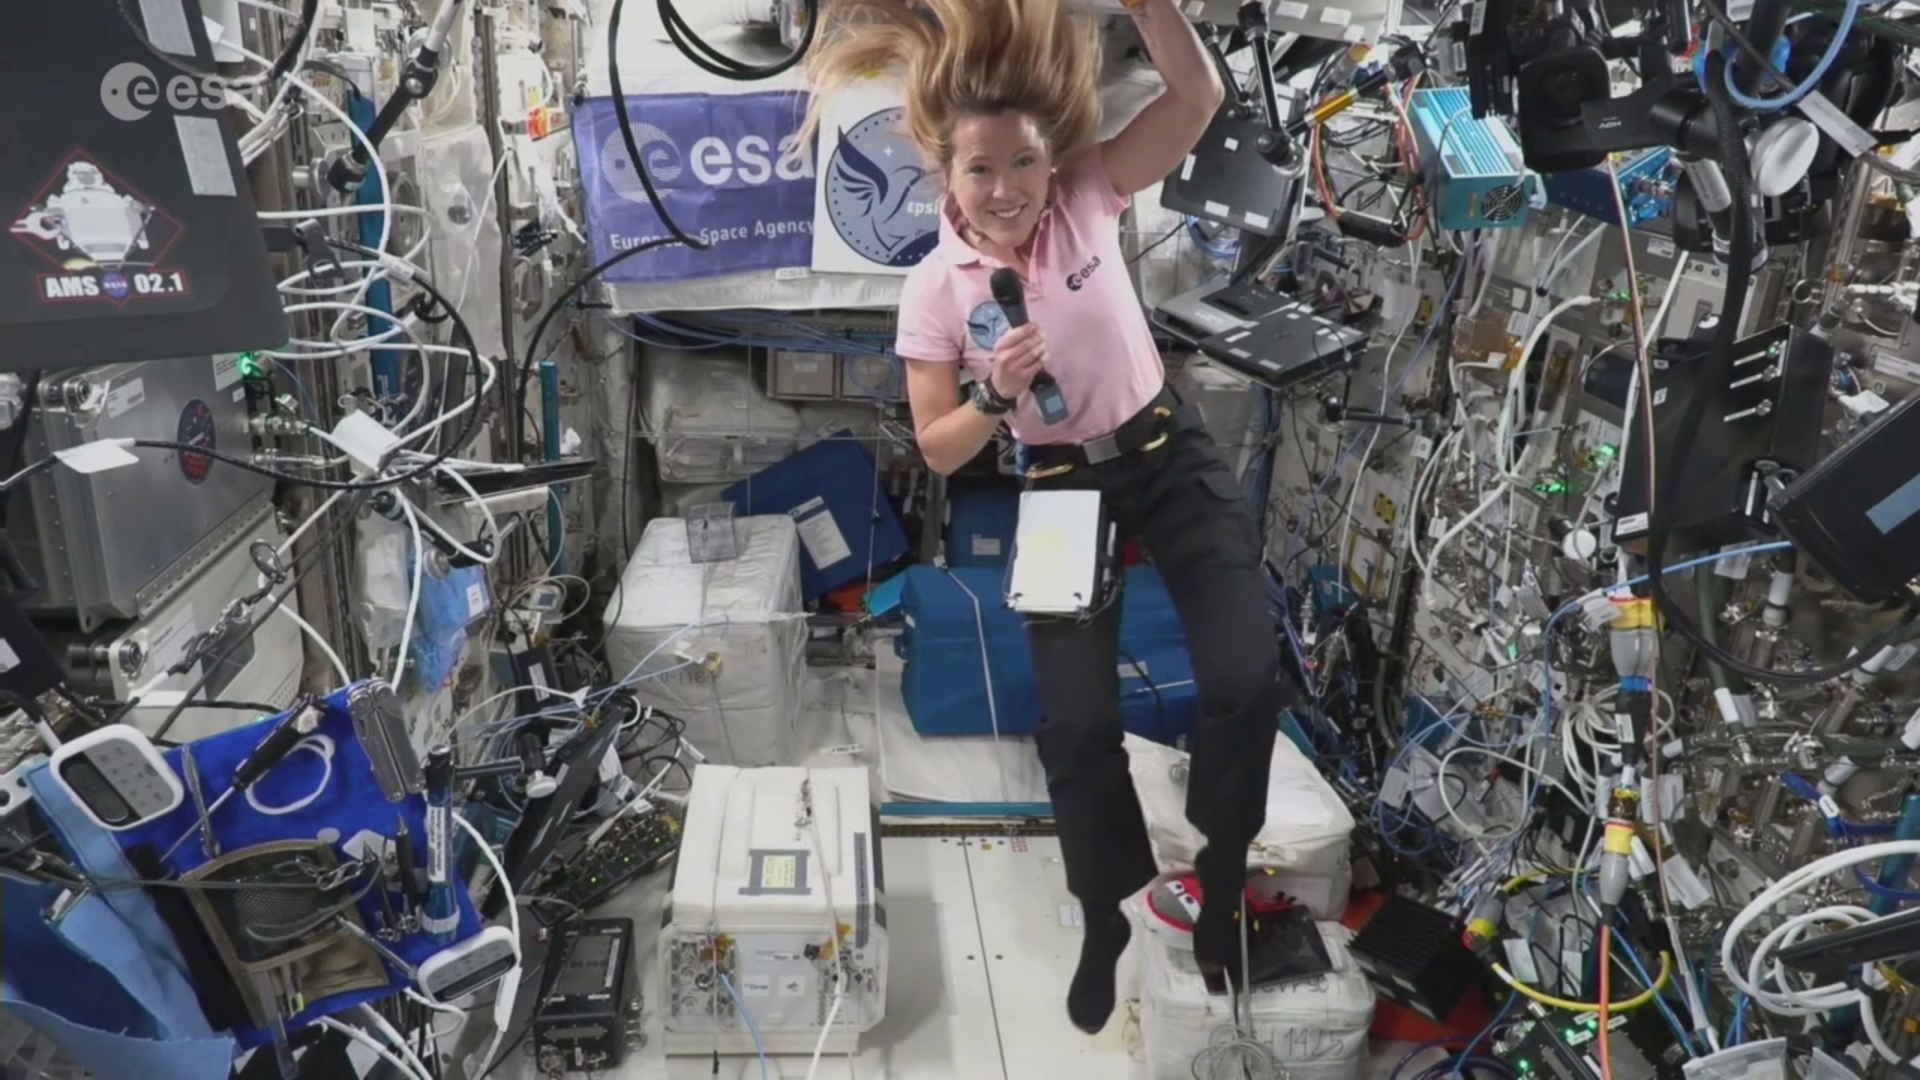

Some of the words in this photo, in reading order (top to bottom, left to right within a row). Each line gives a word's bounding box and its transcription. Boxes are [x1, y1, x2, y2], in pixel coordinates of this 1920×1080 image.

[690, 134, 816, 185] esa
[699, 226, 748, 246] Space
[754, 219, 814, 239] Agency
[1080, 255, 1101, 278] esa
[45, 275, 100, 298] AMS
[133, 272, 184, 294] 02.1
